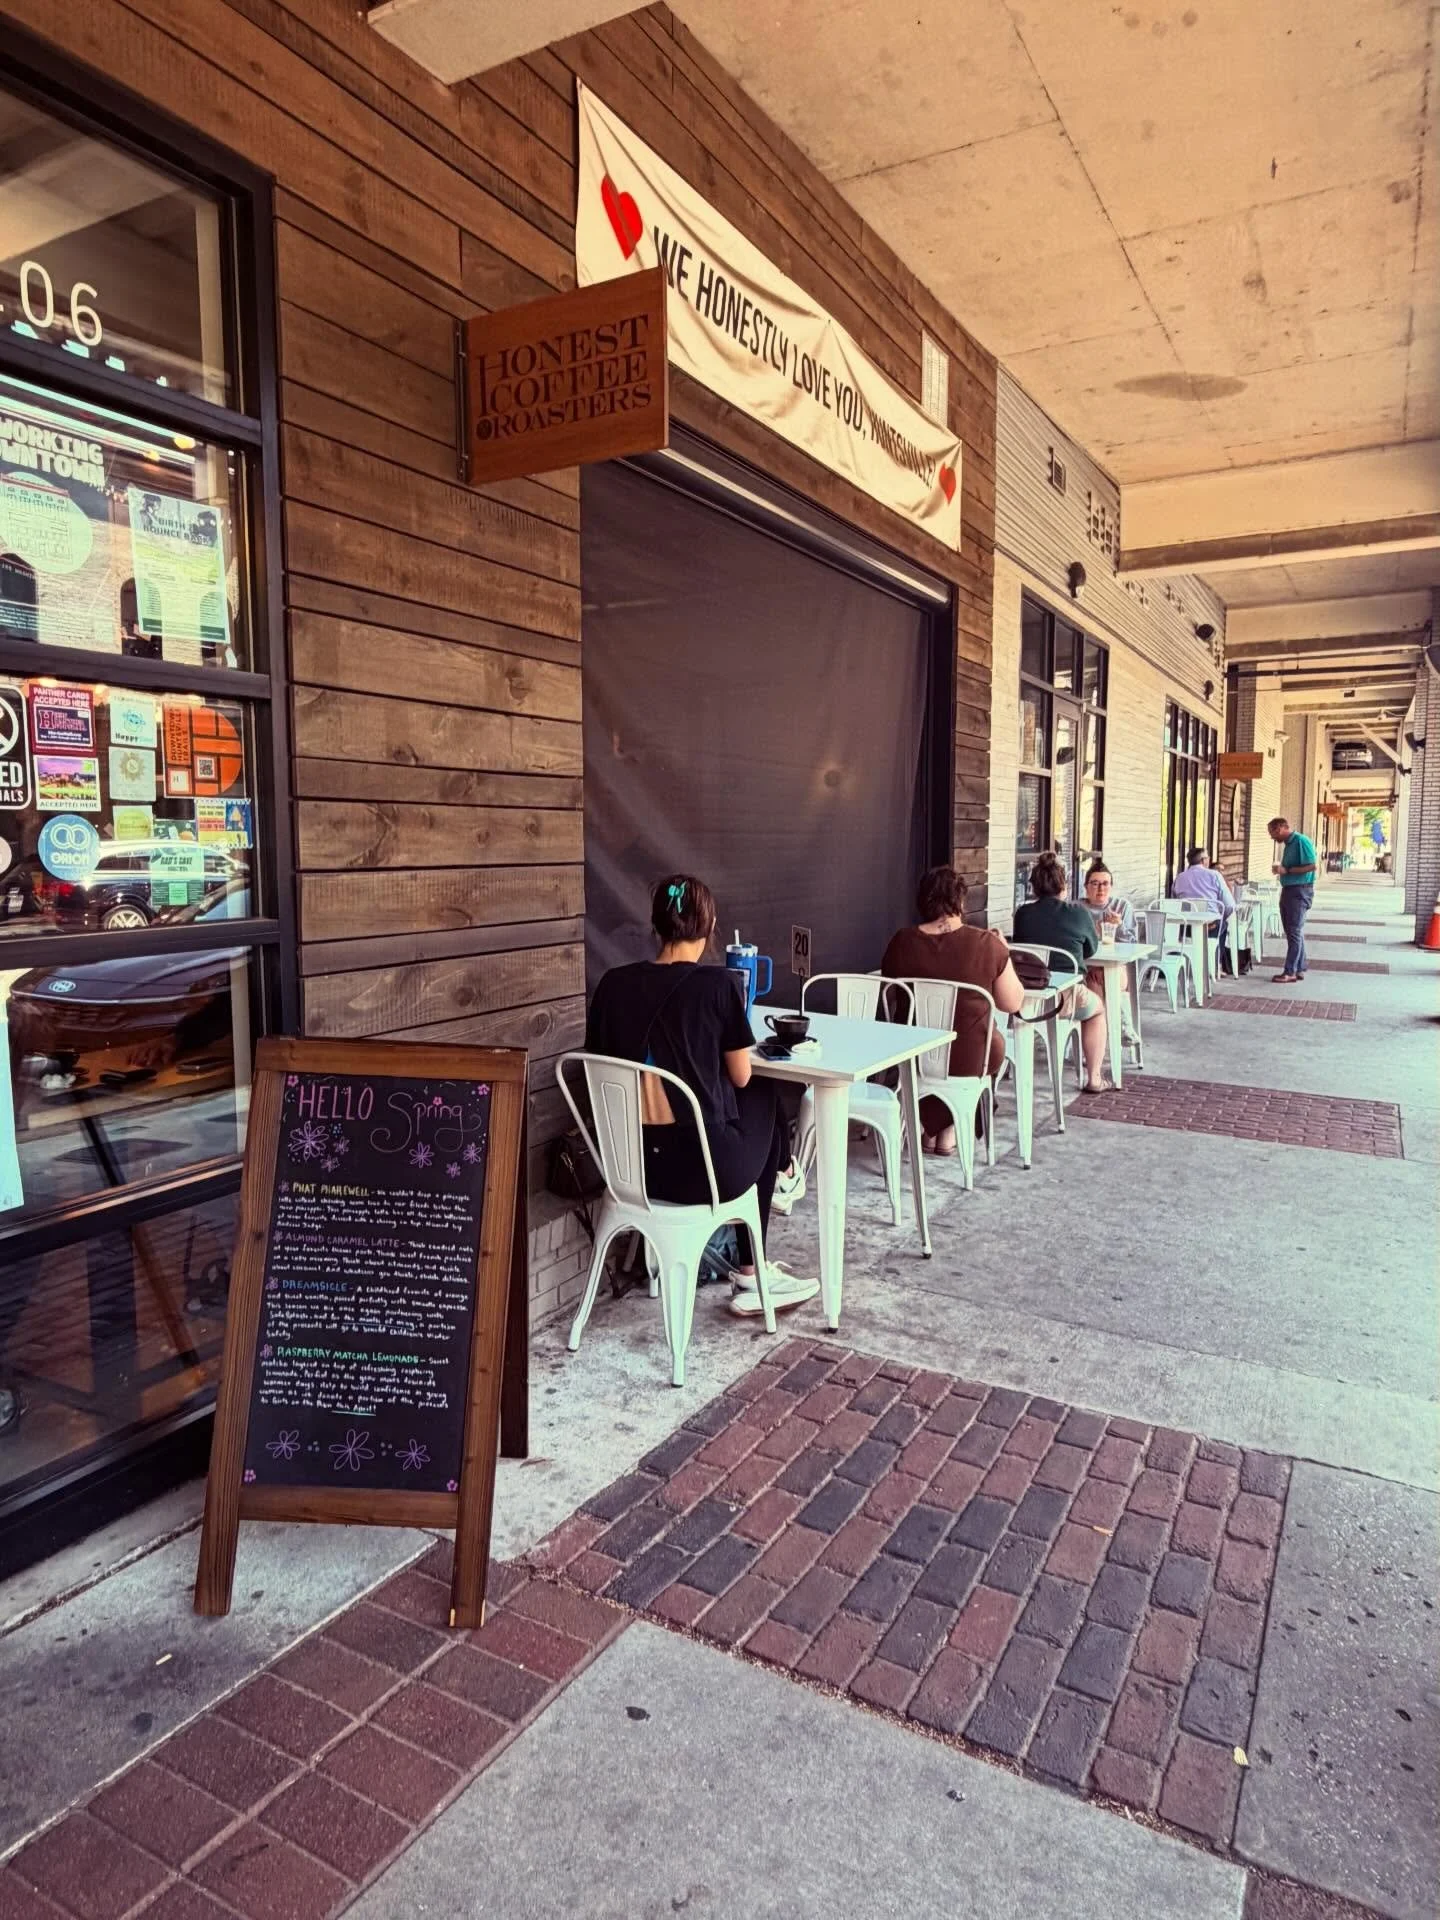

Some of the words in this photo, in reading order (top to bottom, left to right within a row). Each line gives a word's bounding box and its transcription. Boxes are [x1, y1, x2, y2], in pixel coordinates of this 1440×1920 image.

[0, 260, 103, 346] 06
[654, 225, 692, 302] WE
[696, 261, 788, 376] HONESTLY
[793, 343, 831, 410] LOVE
[834, 376, 866, 440] YOU,
[478, 314, 649, 404] HONEST
[490, 350, 649, 415] COFFEE
[494, 383, 652, 440] ROASTERS
[33, 687, 65, 698] PANTHER
[67, 690, 90, 700] CARDS
[34, 695, 71, 706] ACCEPTED
[72, 699, 90, 708] HERE
[794, 932, 809, 957] 20
[298, 1082, 374, 1121] HELLO
[370, 1091, 482, 1153] Spring
[292, 1181, 317, 1195] PHAT
[285, 1231, 325, 1244] ALMOND
[327, 1235, 368, 1247] CARAMEL
[371, 1237, 400, 1248] LATTE
[282, 1279, 348, 1293] DREAMSICLE
[356, 1285, 363, 1293] A
[277, 1346, 331, 1359] RASPBERRY
[332, 1351, 368, 1360] MATCHA
[372, 1351, 419, 1364] LEMONADE
